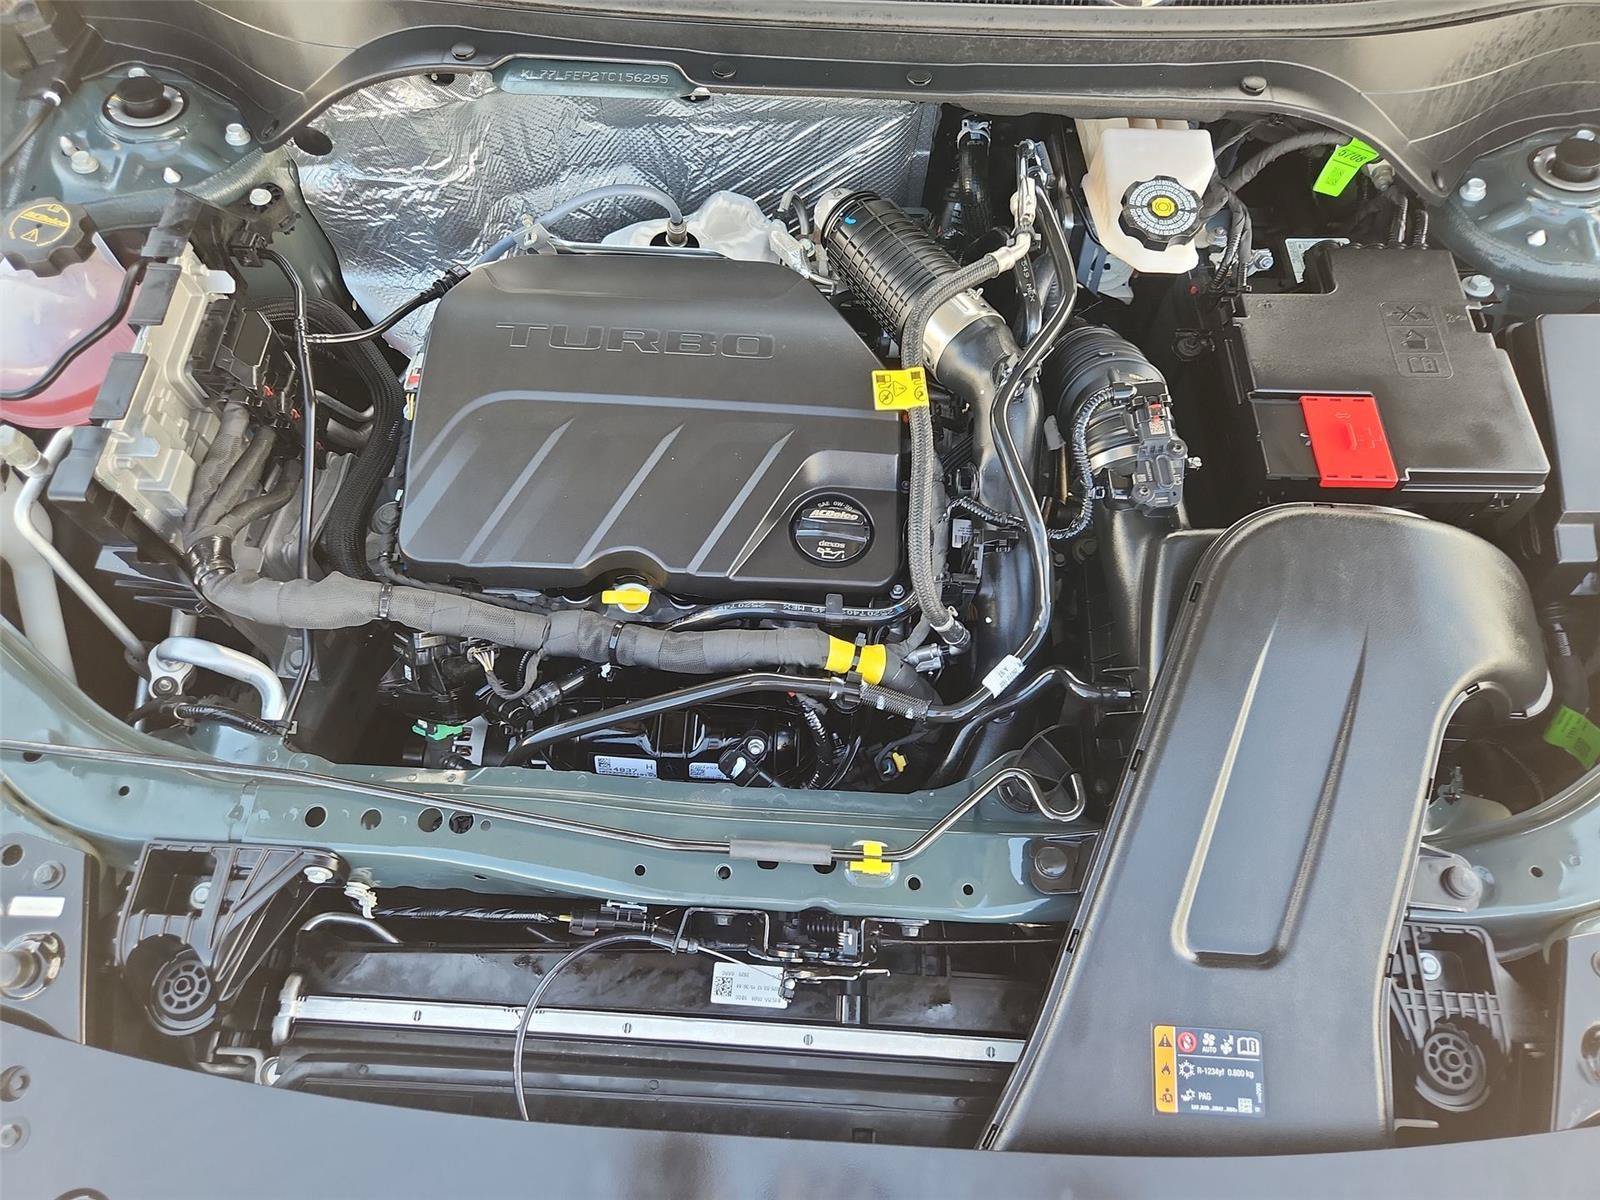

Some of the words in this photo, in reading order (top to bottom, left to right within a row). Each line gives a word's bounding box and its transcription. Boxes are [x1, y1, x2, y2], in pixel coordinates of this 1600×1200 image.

[520, 69, 669, 84] KL77LFEP2TC156295
[496, 323, 775, 359] TURBO
[808, 509, 859, 521] ACDelco
[818, 540, 846, 549] dexos
[1202, 1046, 1217, 1054] AUTO
[1198, 1091, 1213, 1101] PAG
